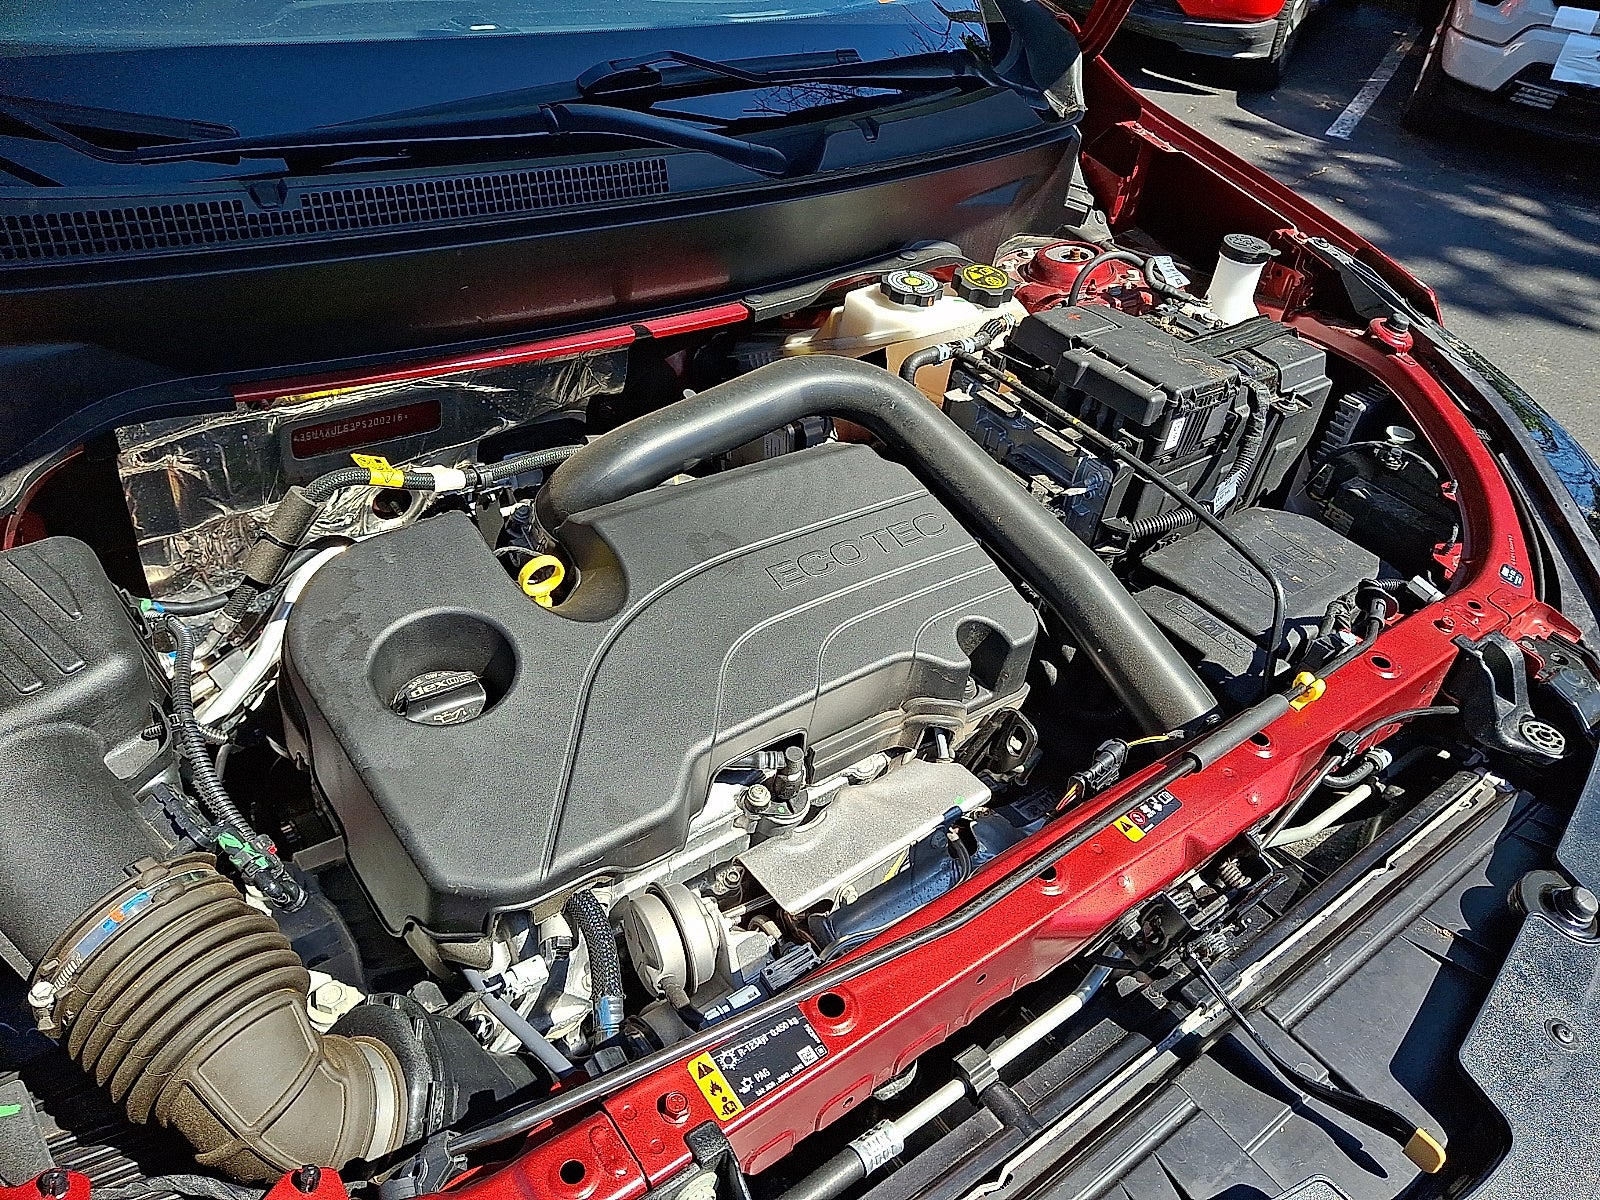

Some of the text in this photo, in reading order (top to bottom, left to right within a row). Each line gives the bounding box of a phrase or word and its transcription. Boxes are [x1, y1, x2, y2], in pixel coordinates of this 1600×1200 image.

[765, 513, 949, 590] ECOTEC
[787, 1016, 798, 1027] kg
[753, 1067, 771, 1083] PAG
